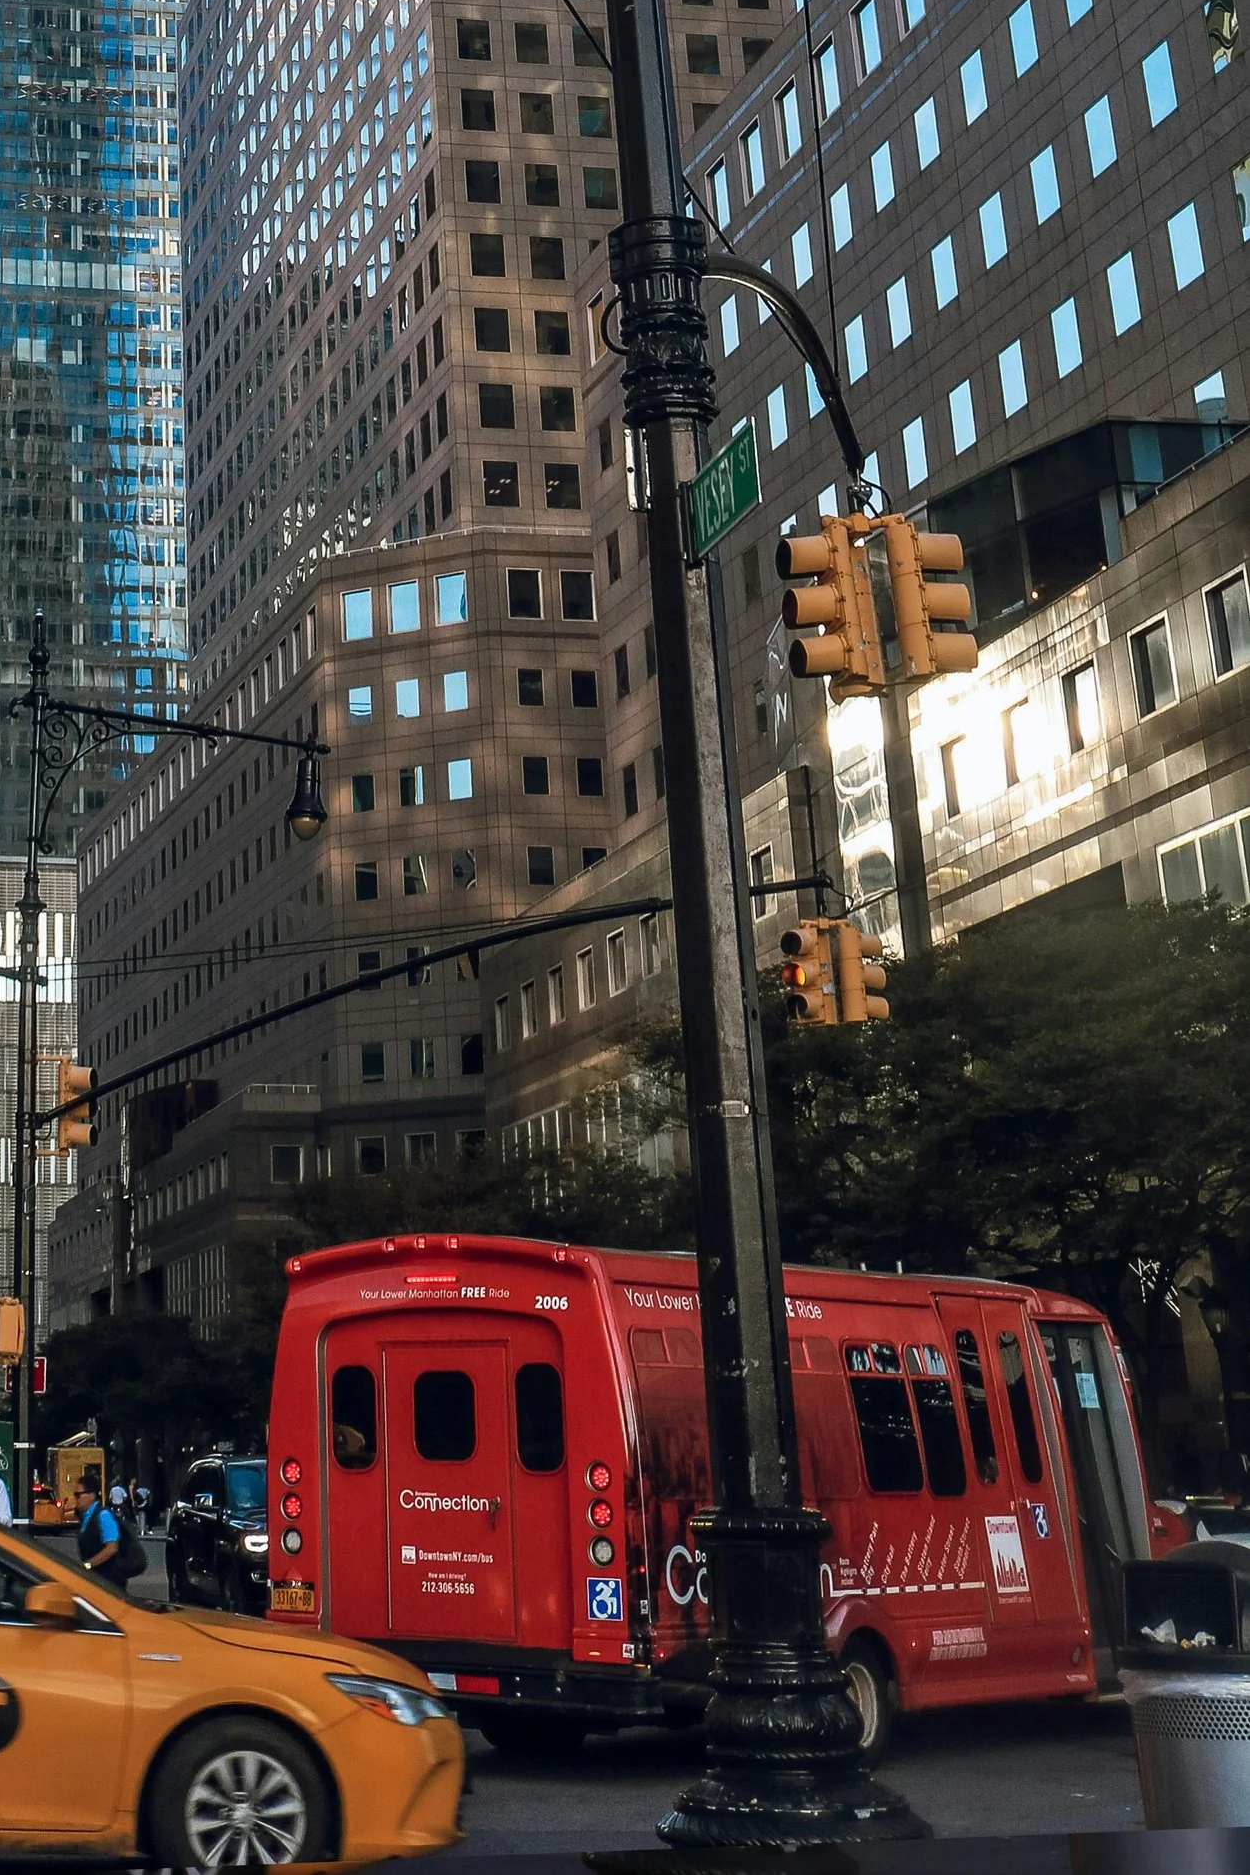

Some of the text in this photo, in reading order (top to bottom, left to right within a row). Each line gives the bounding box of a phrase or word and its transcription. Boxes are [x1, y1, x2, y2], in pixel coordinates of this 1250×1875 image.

[695, 437, 751, 542] VESEY ST
[360, 1287, 510, 1299] Your Lower Manhattan FREE Ride
[624, 1288, 654, 1308] Your
[655, 1290, 693, 1311] Lower
[534, 1295, 569, 1310] 2006
[796, 1301, 823, 1320] Ride
[400, 1489, 489, 1512] Connection
[418, 1549, 494, 1564] DowntownNY.com/bus
[421, 1581, 475, 1595] 212-306-5656
